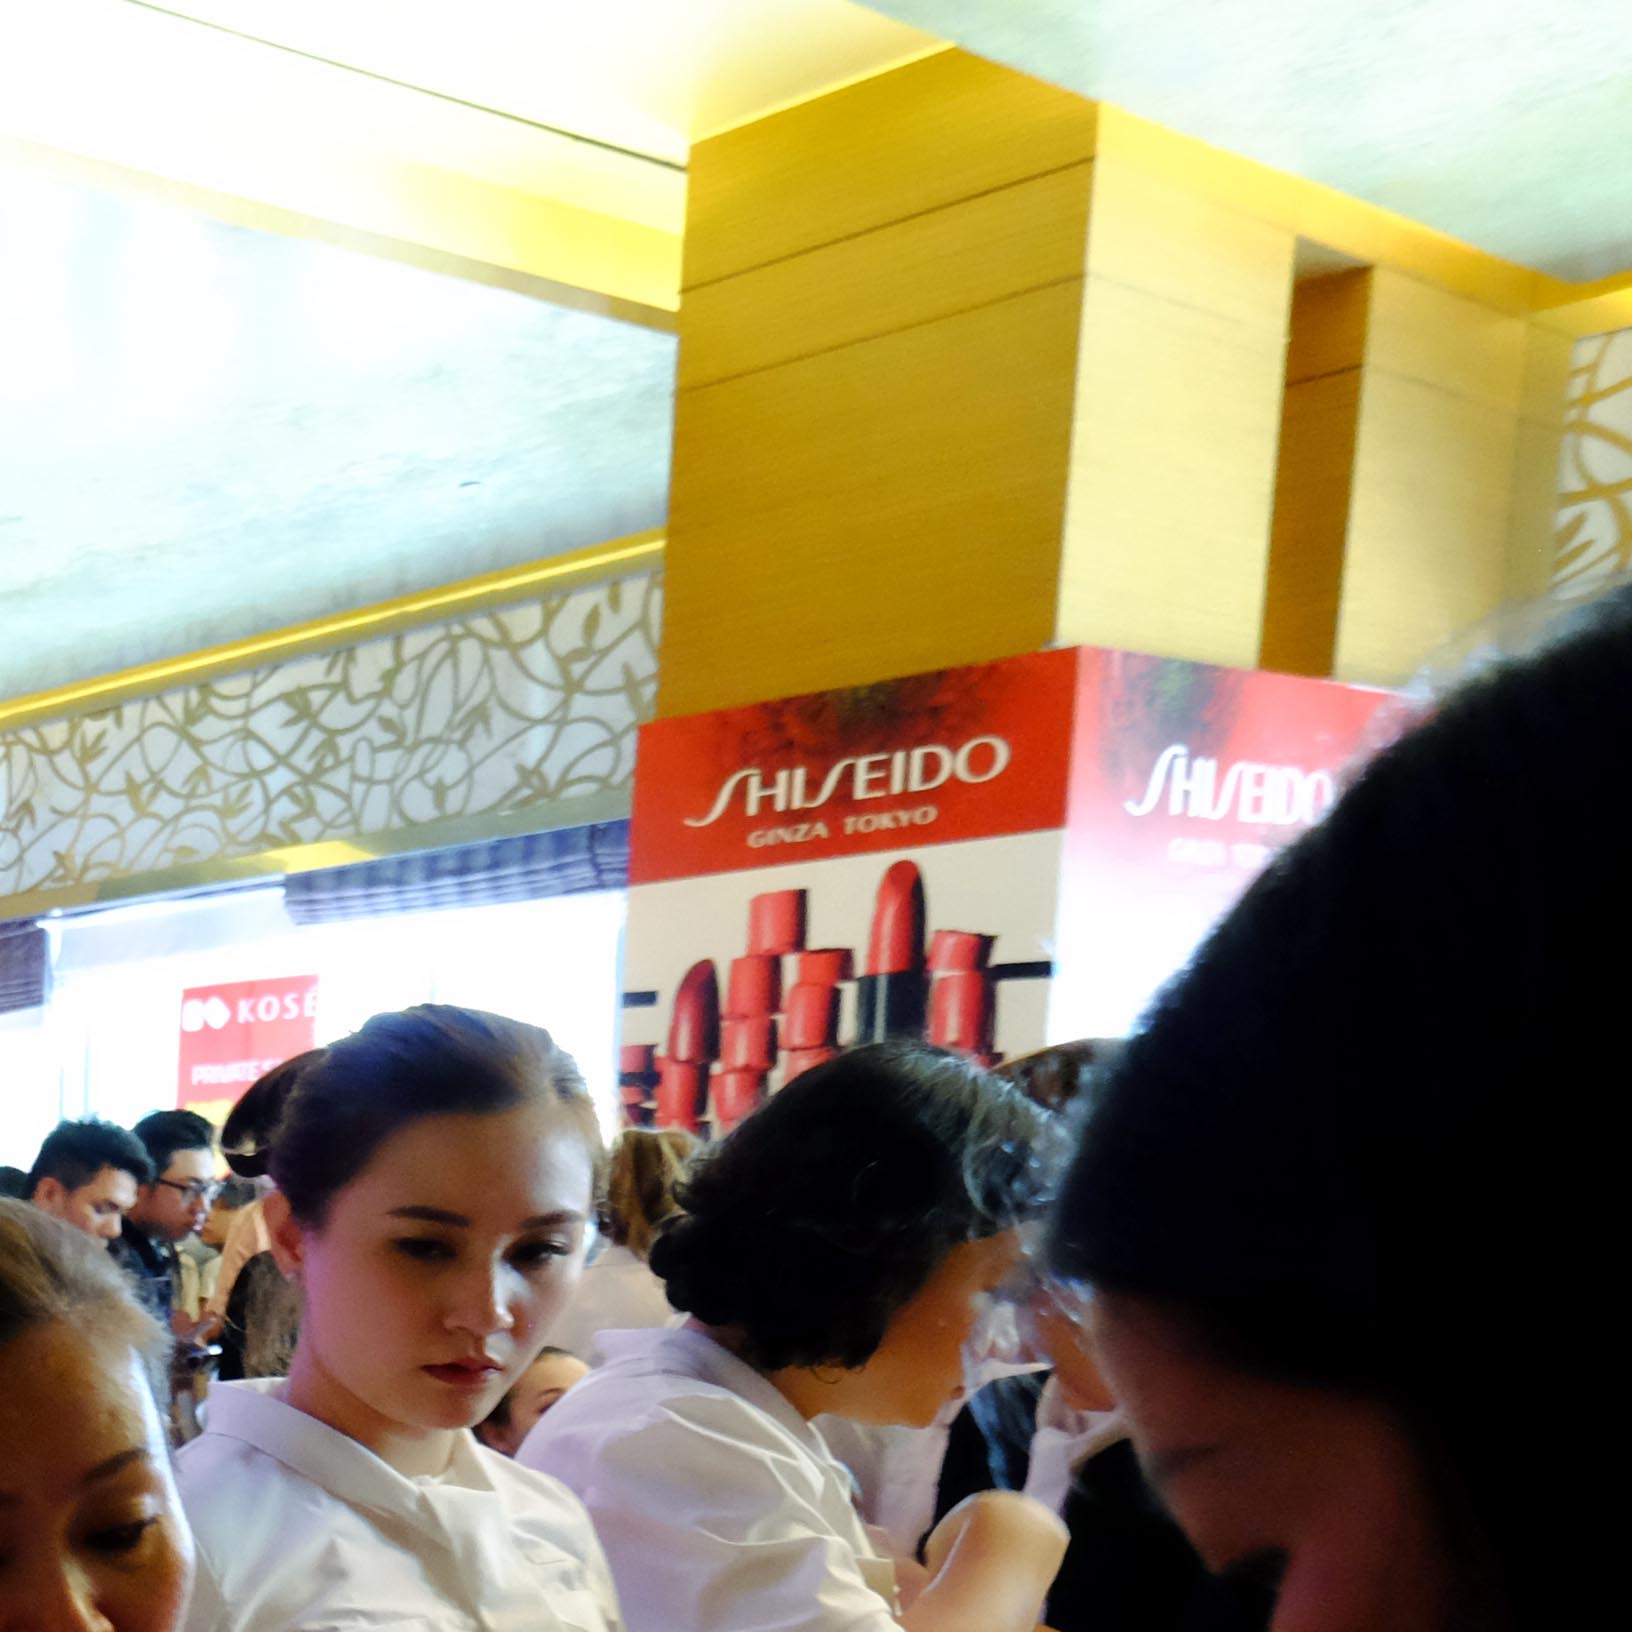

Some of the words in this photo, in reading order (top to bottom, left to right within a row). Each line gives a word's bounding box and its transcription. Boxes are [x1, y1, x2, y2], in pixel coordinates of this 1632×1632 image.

[682, 734, 1012, 828] SHISEIDO
[1123, 743, 1337, 827] SHISEIDO
[746, 820, 830, 849] GINZA
[843, 805, 938, 835] TOKYO
